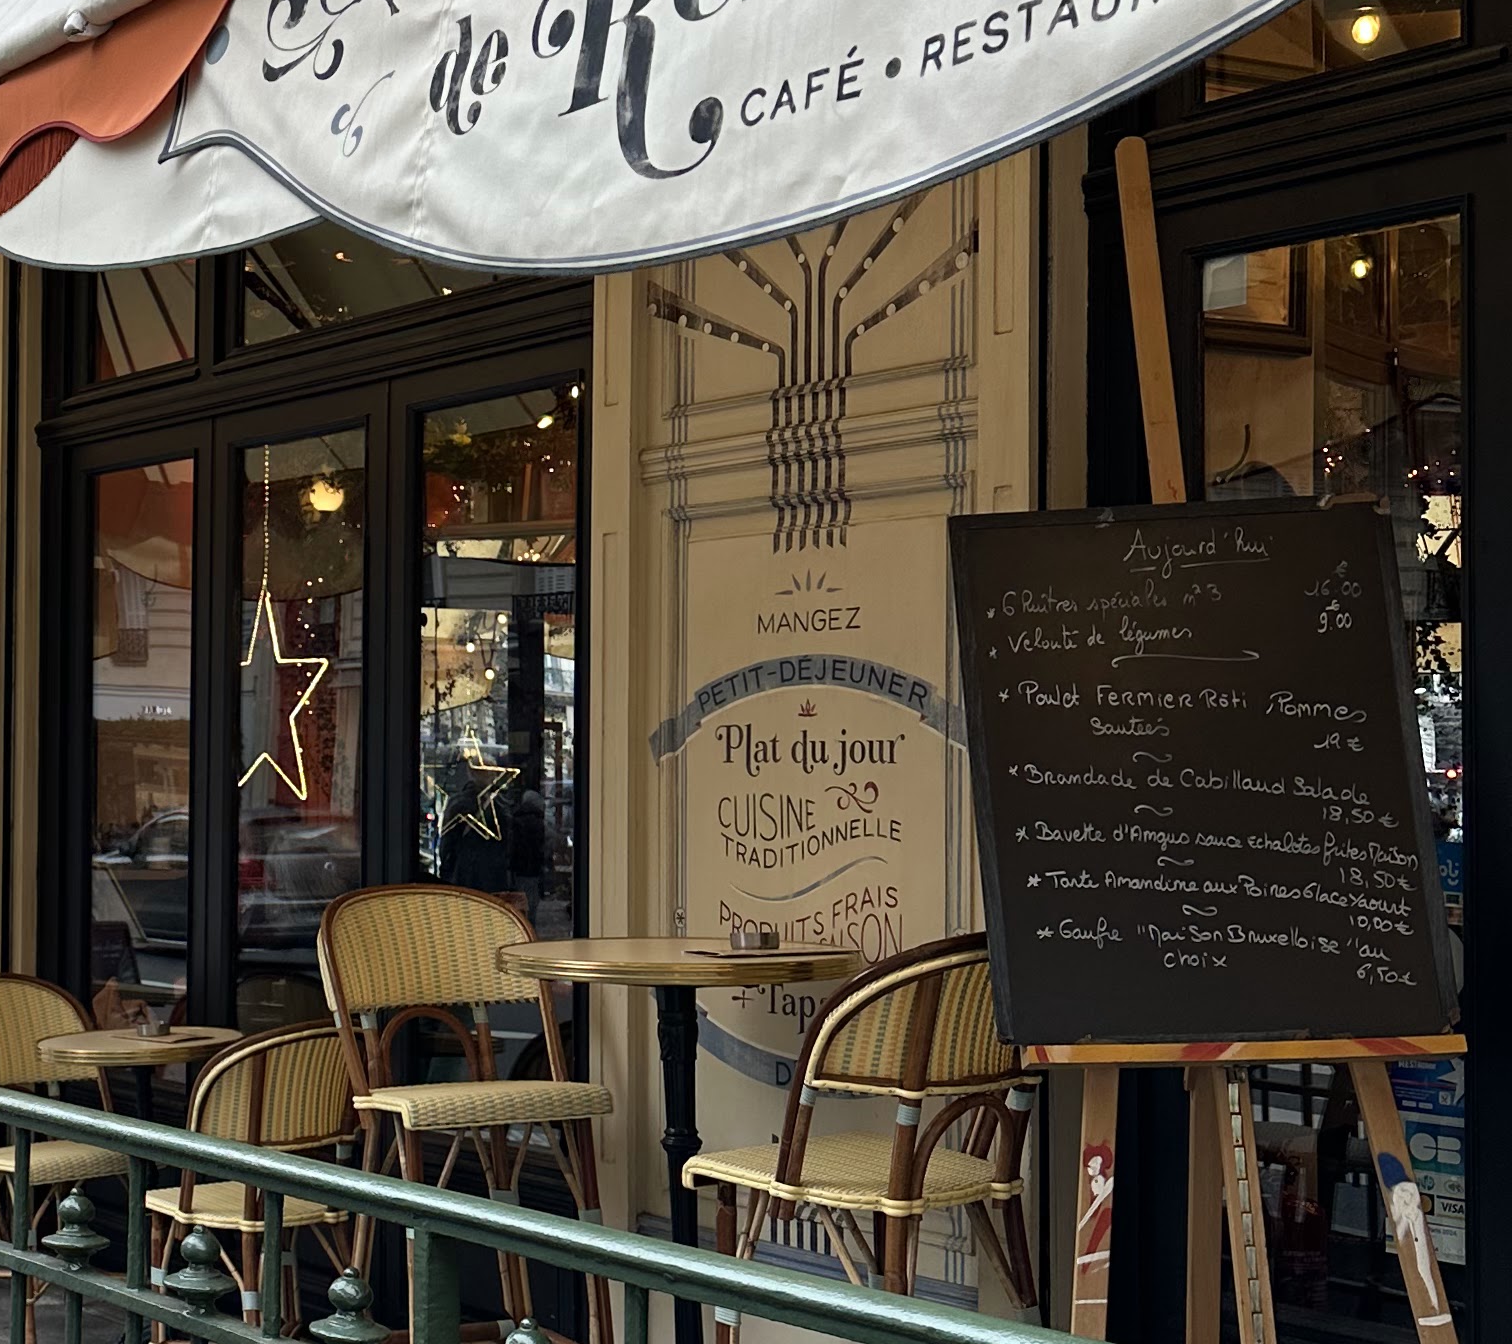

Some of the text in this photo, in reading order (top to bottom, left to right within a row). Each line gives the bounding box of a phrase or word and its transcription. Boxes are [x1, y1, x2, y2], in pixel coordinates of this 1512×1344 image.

[430, 16, 509, 136] de
[740, 46, 865, 127] CAFÉ
[756, 606, 862, 635] MANGEZ
[1087, 624, 1106, 647] de
[1119, 615, 1193, 656] légumes
[697, 656, 929, 714] PETIT-DÉJEUNER
[1018, 680, 1081, 709] Poulet
[714, 723, 906, 778] Plat du jour
[1024, 763, 1371, 806] Brandade de Cabillaud Salade
[718, 791, 817, 843] CUISINE
[720, 819, 902, 870] TRADITIONNELLE
[1034, 821, 1107, 843] Bavette
[1112, 823, 1190, 852] d'Angus
[1194, 834, 1244, 848] sauce
[1322, 831, 1367, 866] frites
[832, 885, 899, 929] FRAIS
[1044, 869, 1412, 917] Tarte Amandine aux Poires Glace Yaourt
[1058, 916, 1124, 950] Gaufre
[757, 983, 829, 1035] Tap
